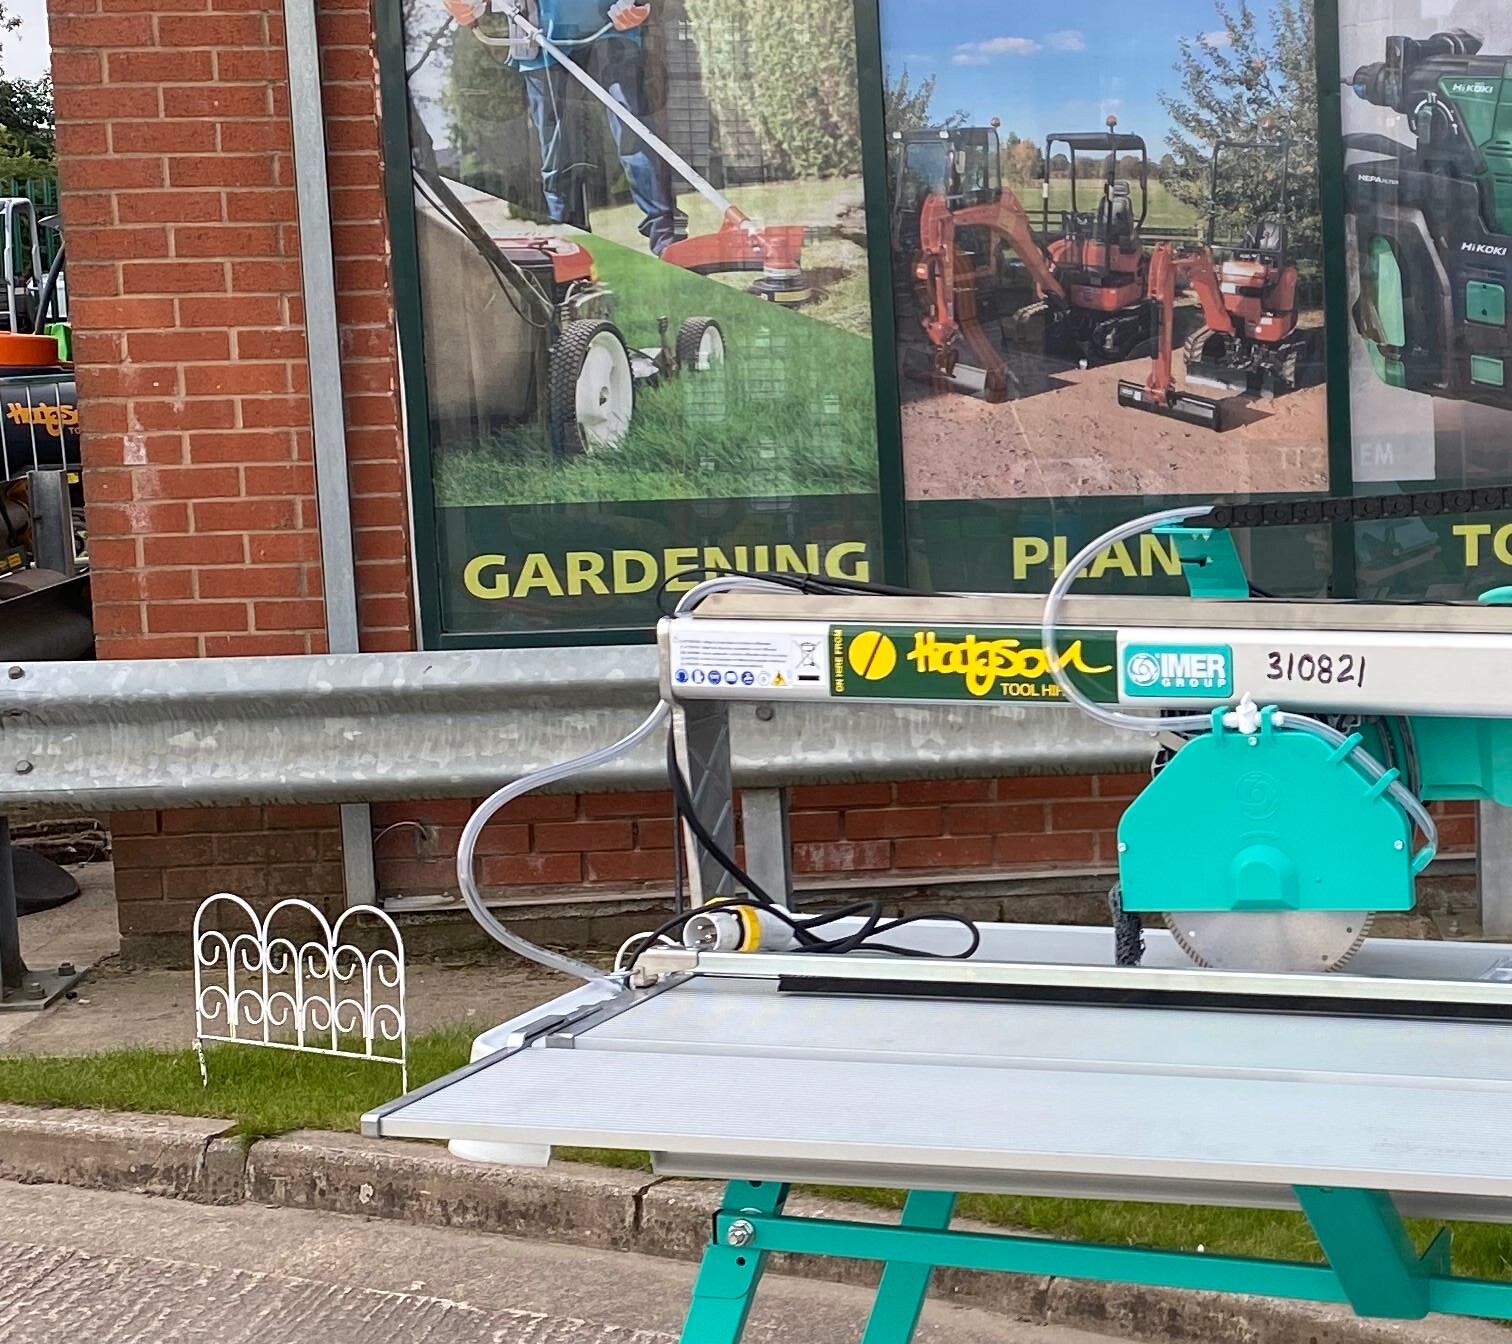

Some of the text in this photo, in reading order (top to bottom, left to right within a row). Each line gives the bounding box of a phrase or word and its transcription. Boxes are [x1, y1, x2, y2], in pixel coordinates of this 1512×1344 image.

[463, 541, 871, 600] GARDENING
[1012, 533, 1184, 581] PLAN
[907, 631, 1112, 697] Hodgson
[1161, 652, 1226, 679] IMER
[1161, 677, 1227, 688] GROUP
[1266, 651, 1366, 688] 310821
[1000, 682, 1039, 696] TOOL
